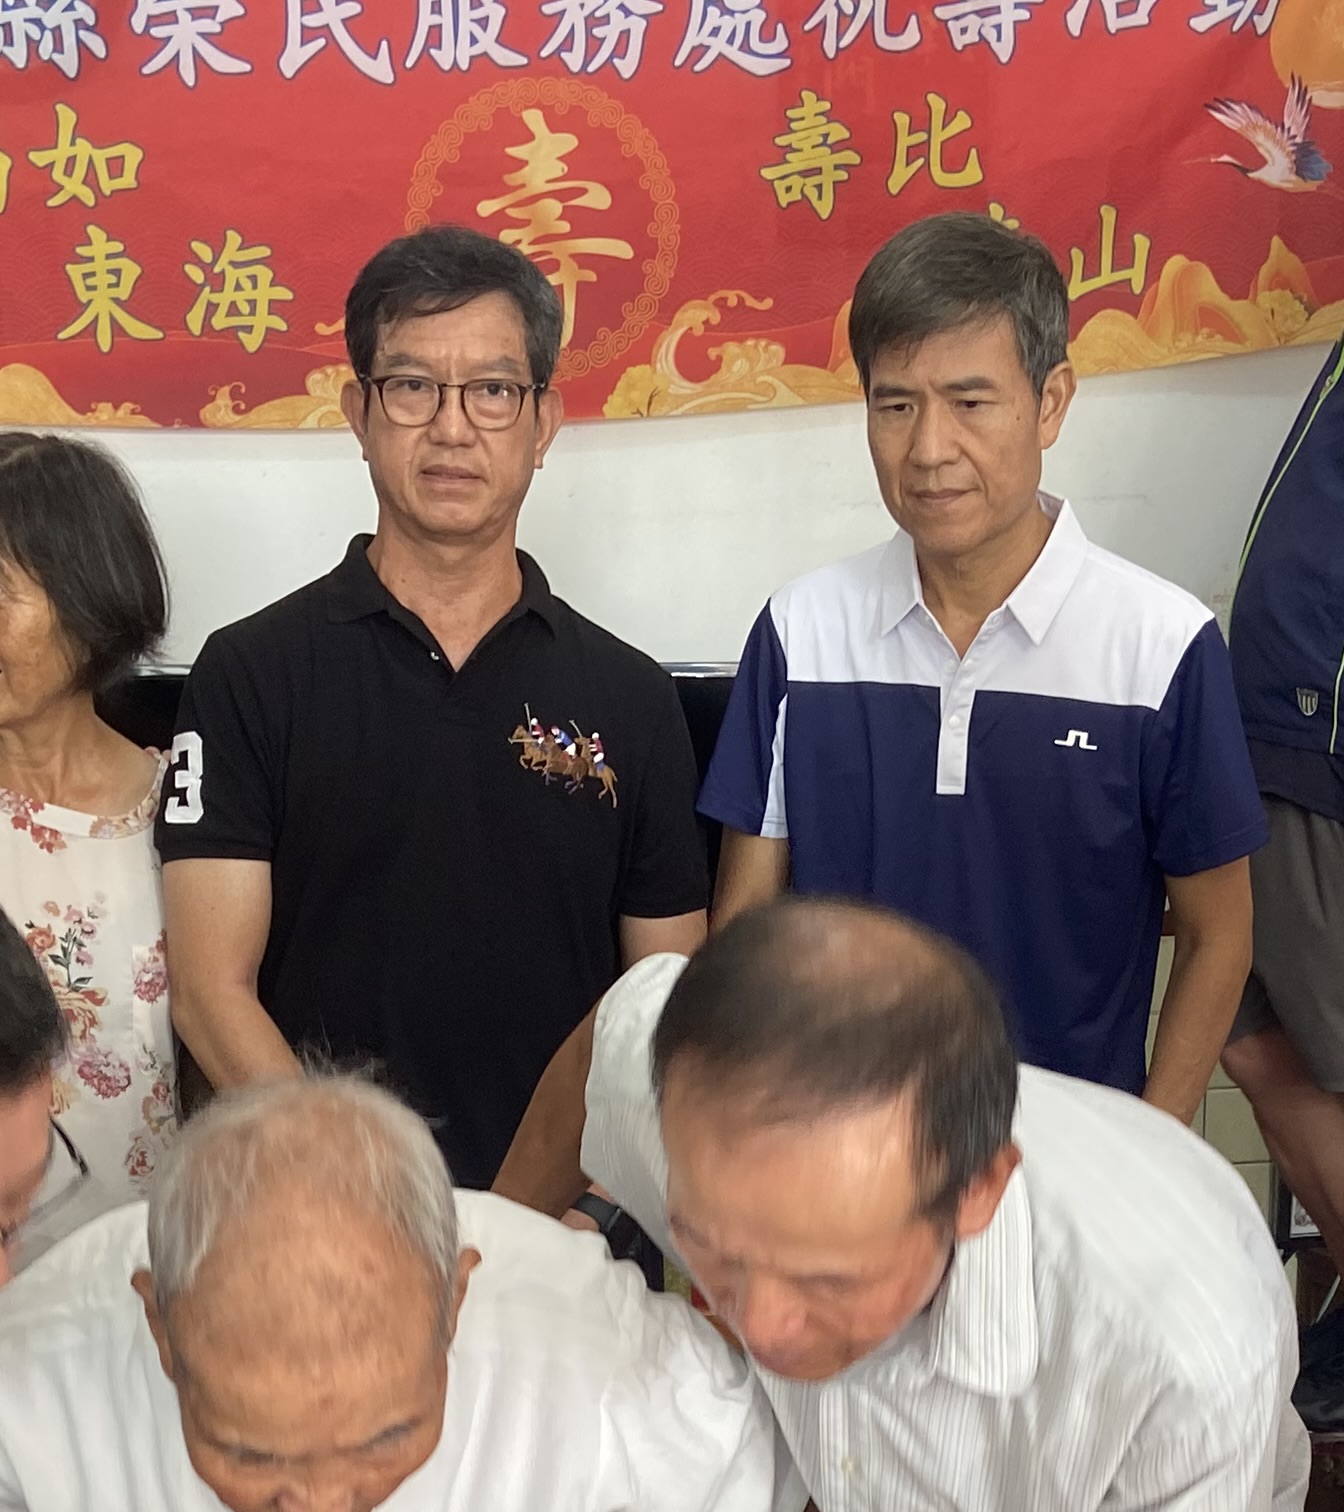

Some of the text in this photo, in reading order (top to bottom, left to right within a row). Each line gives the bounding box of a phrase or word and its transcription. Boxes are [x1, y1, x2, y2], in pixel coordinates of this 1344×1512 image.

[759, 89, 983, 220] 壽比
[56, 225, 294, 353] 東海
[164, 730, 204, 824] 3
